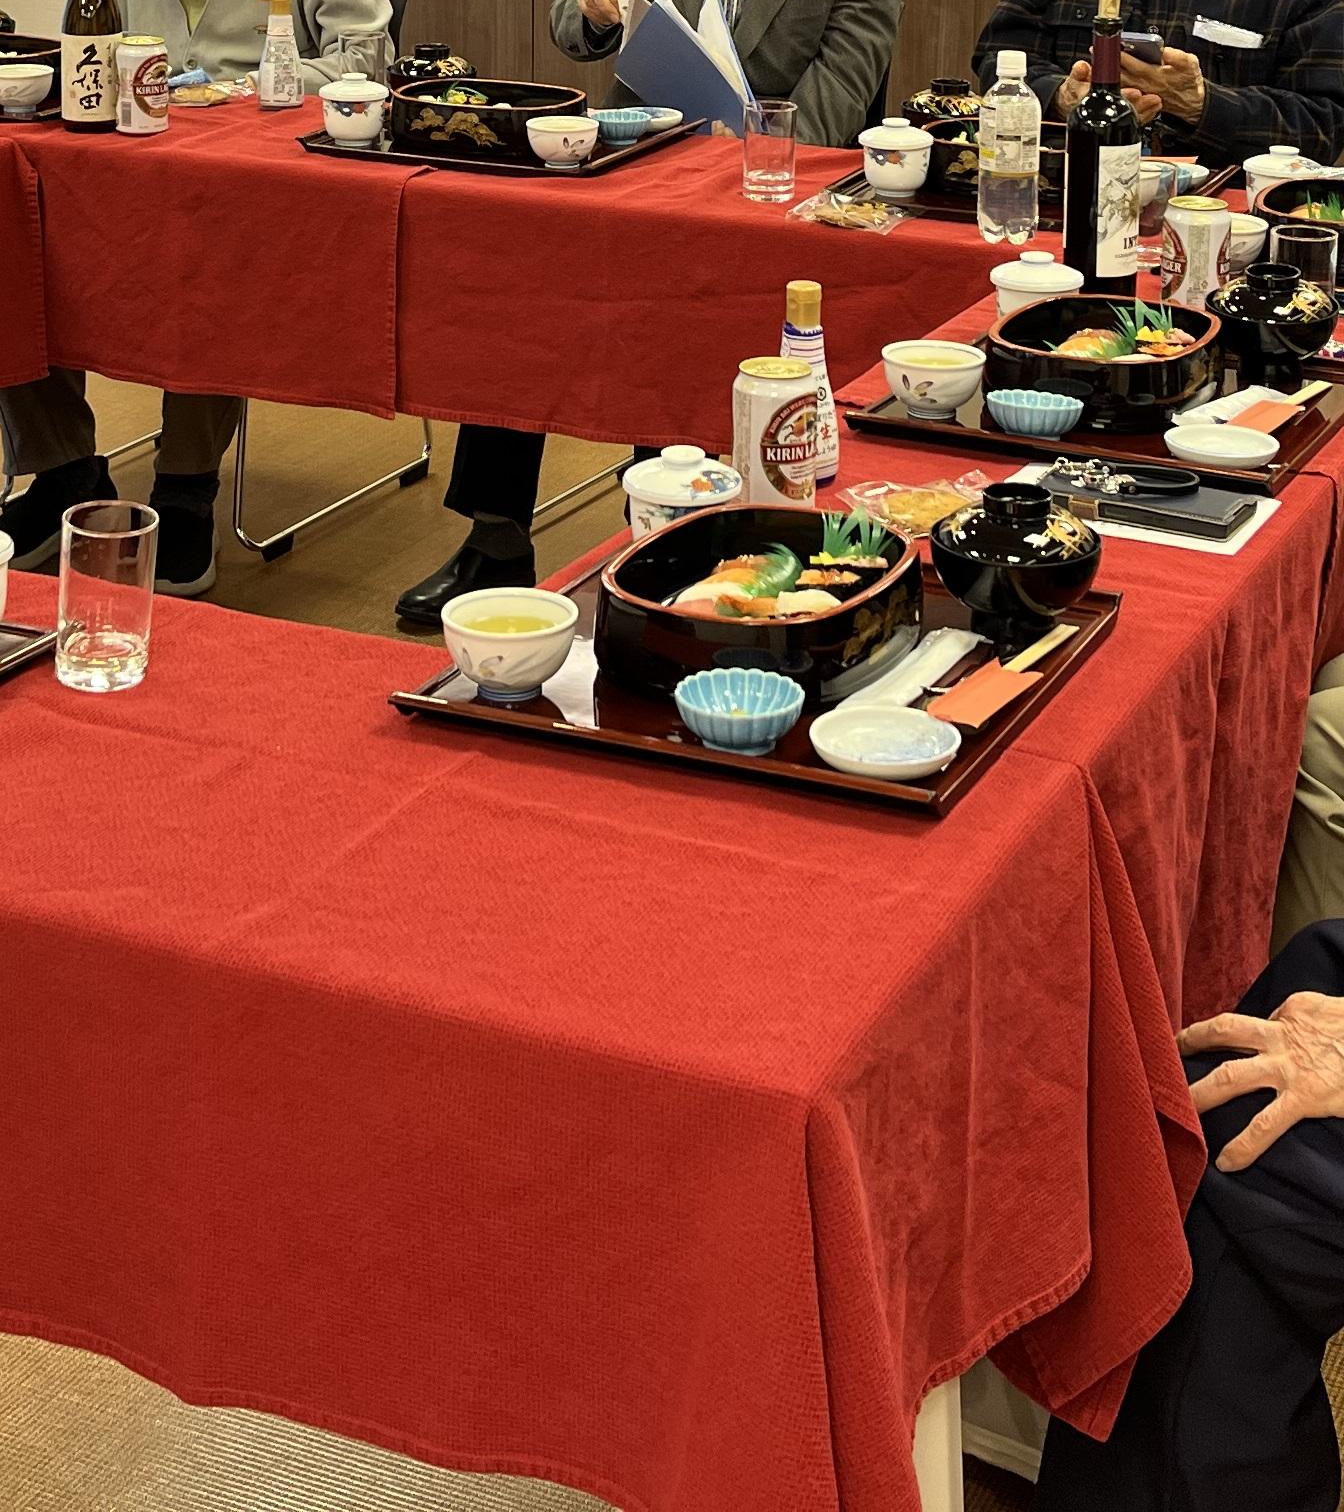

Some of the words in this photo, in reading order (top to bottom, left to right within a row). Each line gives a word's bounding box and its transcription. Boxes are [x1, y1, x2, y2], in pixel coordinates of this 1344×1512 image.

[72, 43, 103, 110] 久保田
[766, 445, 804, 461] KIRIN
